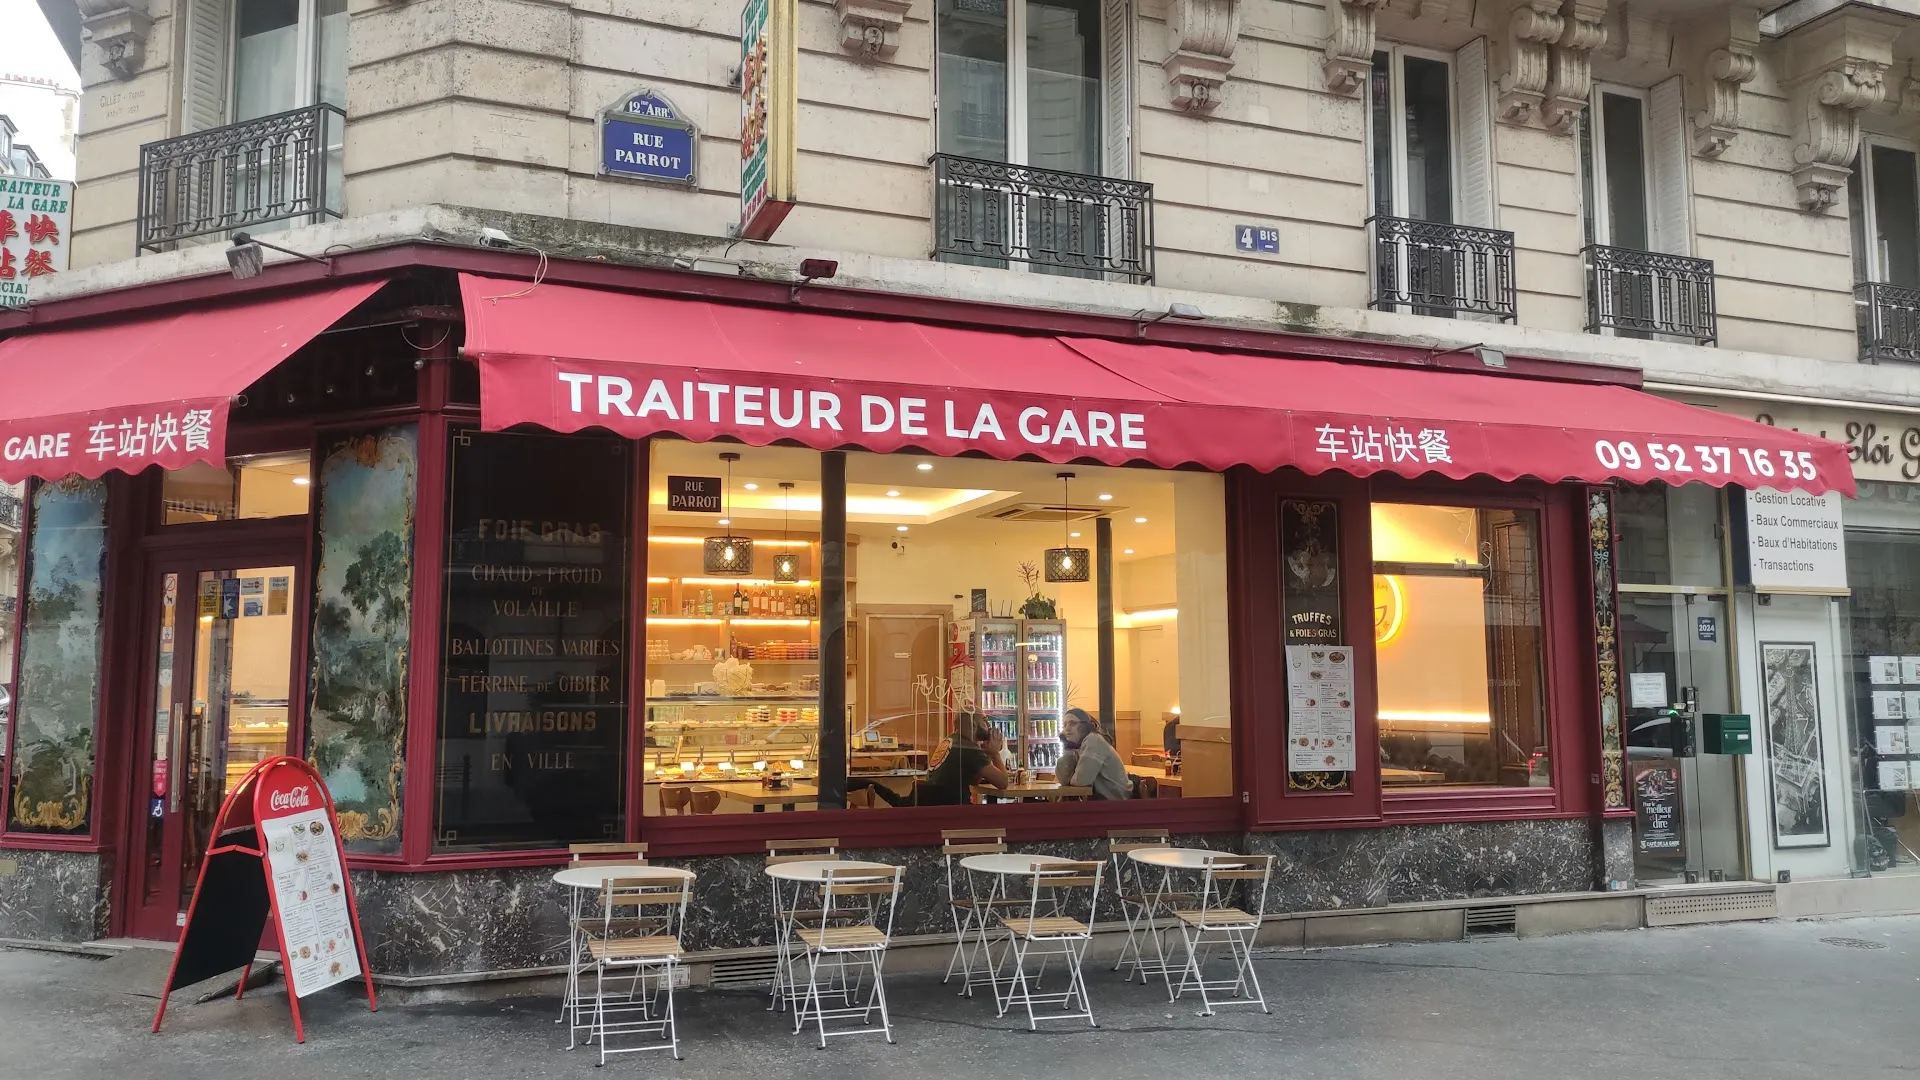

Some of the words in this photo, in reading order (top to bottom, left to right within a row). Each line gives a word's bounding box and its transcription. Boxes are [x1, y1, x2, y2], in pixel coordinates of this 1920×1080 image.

[633, 132, 663, 148] RUE
[615, 149, 681, 169] PARROT
[7, 196, 24, 209] LA
[32, 199, 68, 213] GARE
[1241, 228, 1253, 248] 4
[1260, 230, 1278, 242] BIS
[558, 372, 843, 431] TRAITEUR
[861, 395, 928, 436] DE
[945, 400, 1006, 440] LA
[1018, 407, 1147, 449] GARE
[4, 432, 71, 461] GARE
[85, 409, 213, 462] 车站快餐
[1315, 423, 1453, 464] 车站快餐
[1595, 440, 1642, 470] 09
[1647, 443, 1693, 472] 52
[1694, 445, 1731, 474] 37
[1738, 448, 1775, 477] 16
[1779, 450, 1817, 480] 35
[685, 481, 704, 492] RUE
[672, 495, 719, 508] PARROT
[1755, 492, 1788, 505] Gestion
[1790, 494, 1826, 507] Locative
[1756, 514, 1778, 526] Baux
[1781, 515, 1838, 529] Commerciaux
[478, 518, 533, 541] FOIE
[541, 521, 601, 545] GRAS
[1758, 536, 1780, 548] Baux
[1782, 537, 1838, 551] d'Habitations
[1759, 558, 1814, 572] Transactions
[492, 600, 578, 618] VOLAILLE
[1292, 612, 1332, 625] TRUFFES
[1290, 629, 1295, 638] &
[1296, 629, 1317, 638] FOIES
[1318, 629, 1337, 638] GRAS
[1699, 624, 1715, 632] 2024
[452, 638, 554, 656] BALLOTTINES
[458, 675, 528, 693] TERRINE
[558, 675, 610, 693] GIBIER
[469, 711, 596, 733] LIVRAISONS
[491, 754, 513, 771] EN
[527, 752, 575, 769] VILLE
[271, 786, 309, 811] Coca-Cola
[1646, 804, 1672, 814] meilleur
